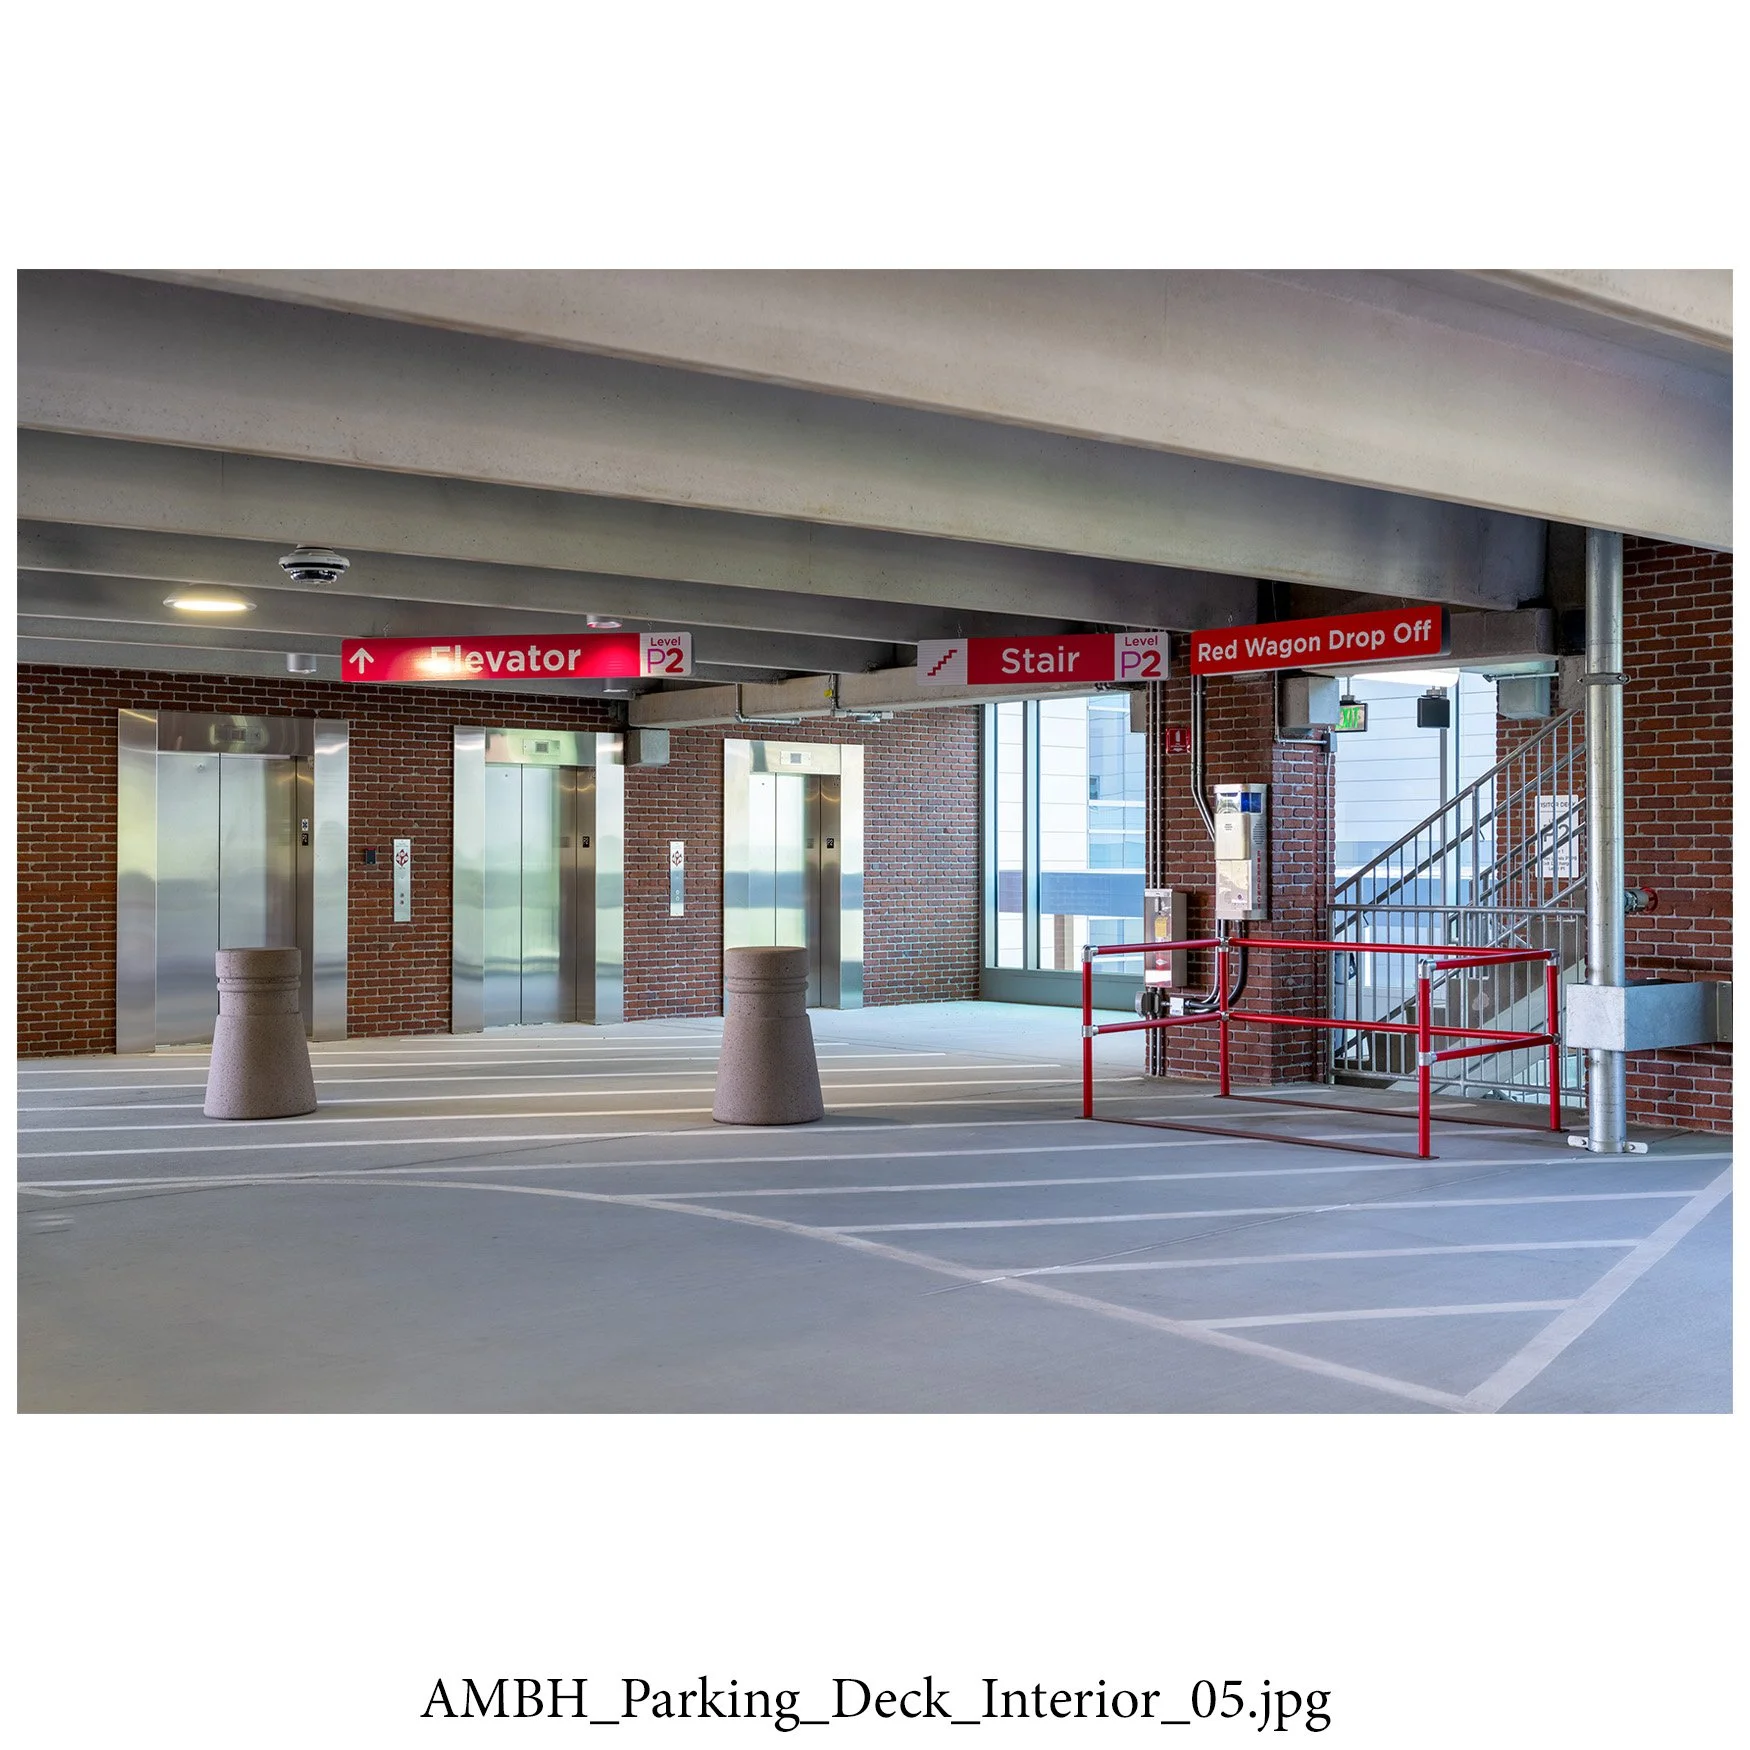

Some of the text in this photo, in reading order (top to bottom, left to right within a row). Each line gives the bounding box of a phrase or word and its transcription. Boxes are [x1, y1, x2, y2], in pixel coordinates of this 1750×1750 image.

[650, 636, 681, 647] Level
[1125, 635, 1158, 647] Level
[1198, 619, 1432, 662] Red Wagon Drop Off
[430, 645, 581, 673] Elevator
[647, 648, 684, 674] P2
[1001, 645, 1080, 674] Stair
[1121, 649, 1162, 678] P2
